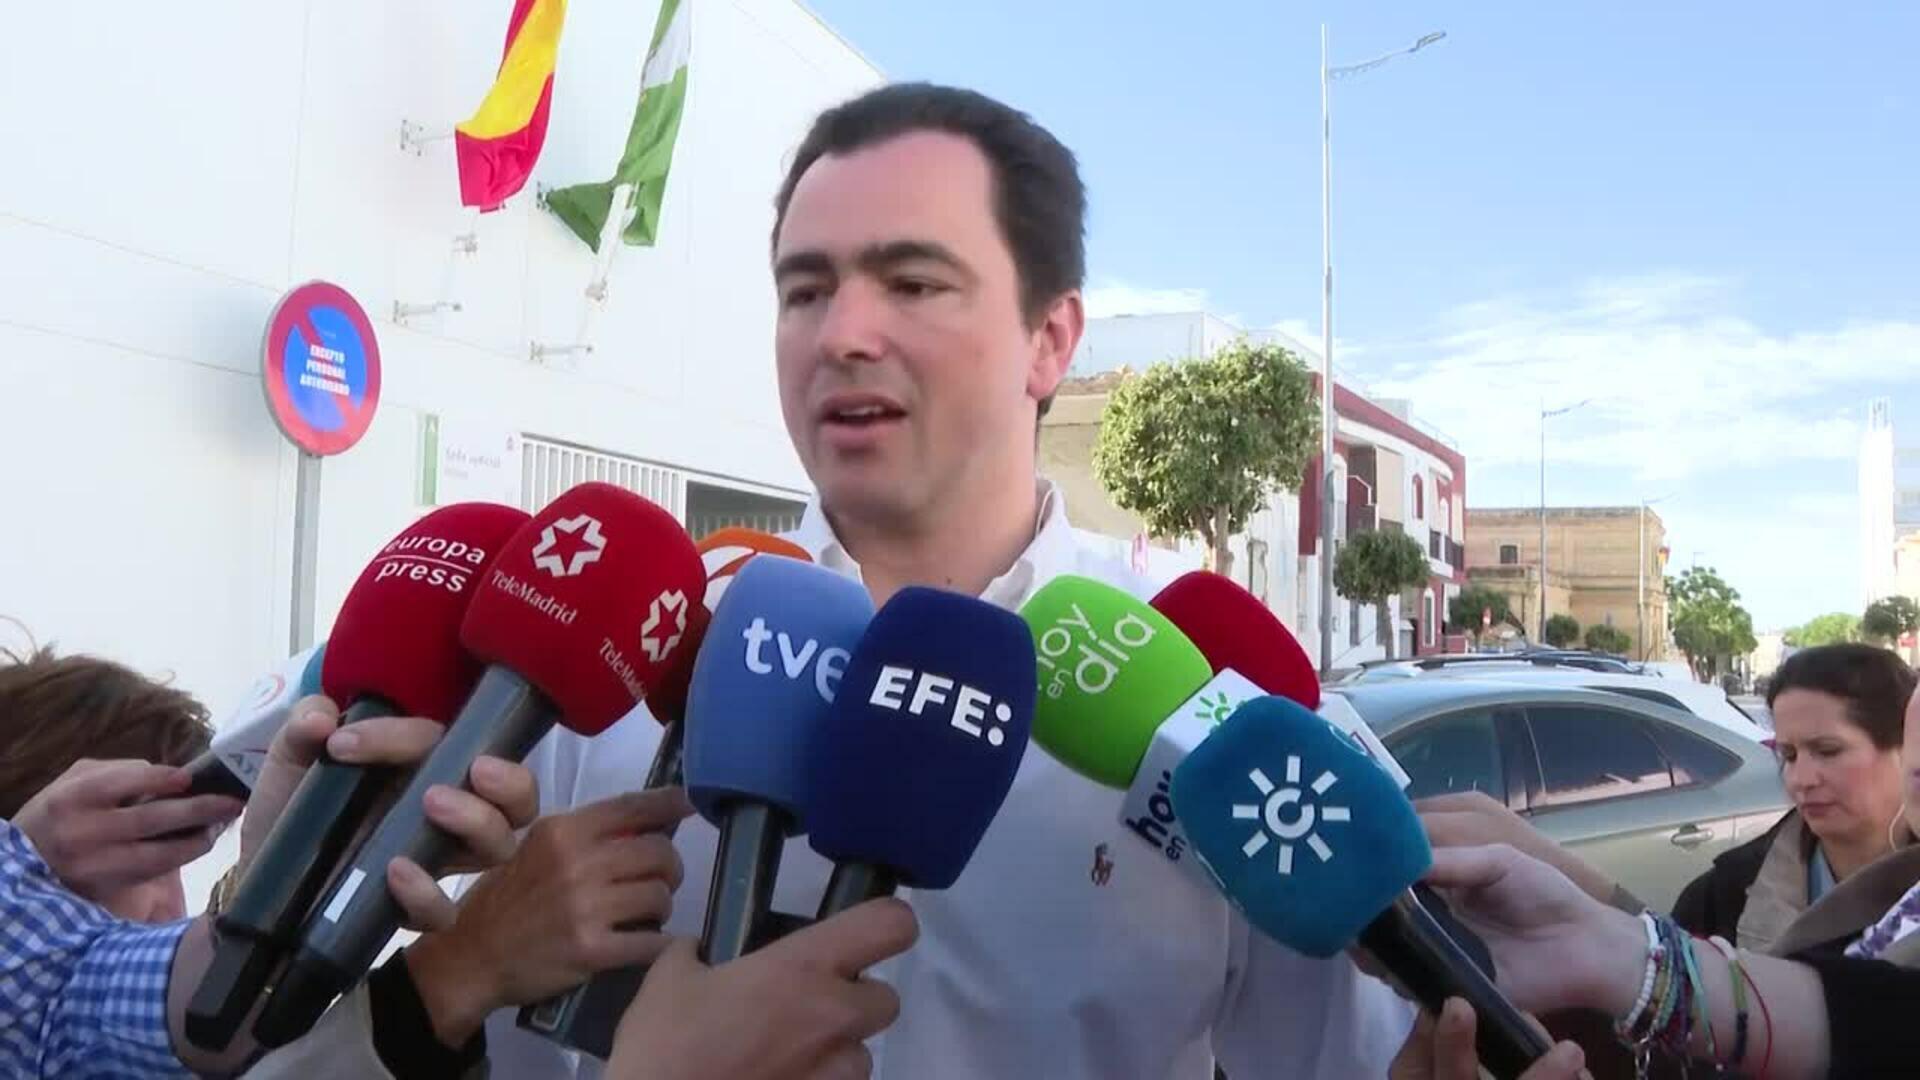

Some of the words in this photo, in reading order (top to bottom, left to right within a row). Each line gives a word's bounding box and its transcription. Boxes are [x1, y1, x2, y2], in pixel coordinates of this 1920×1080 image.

[374, 561, 467, 593] press
[491, 569, 577, 625] TeleMadrid
[1046, 669, 1072, 698] en
[1165, 835, 1188, 861] en
